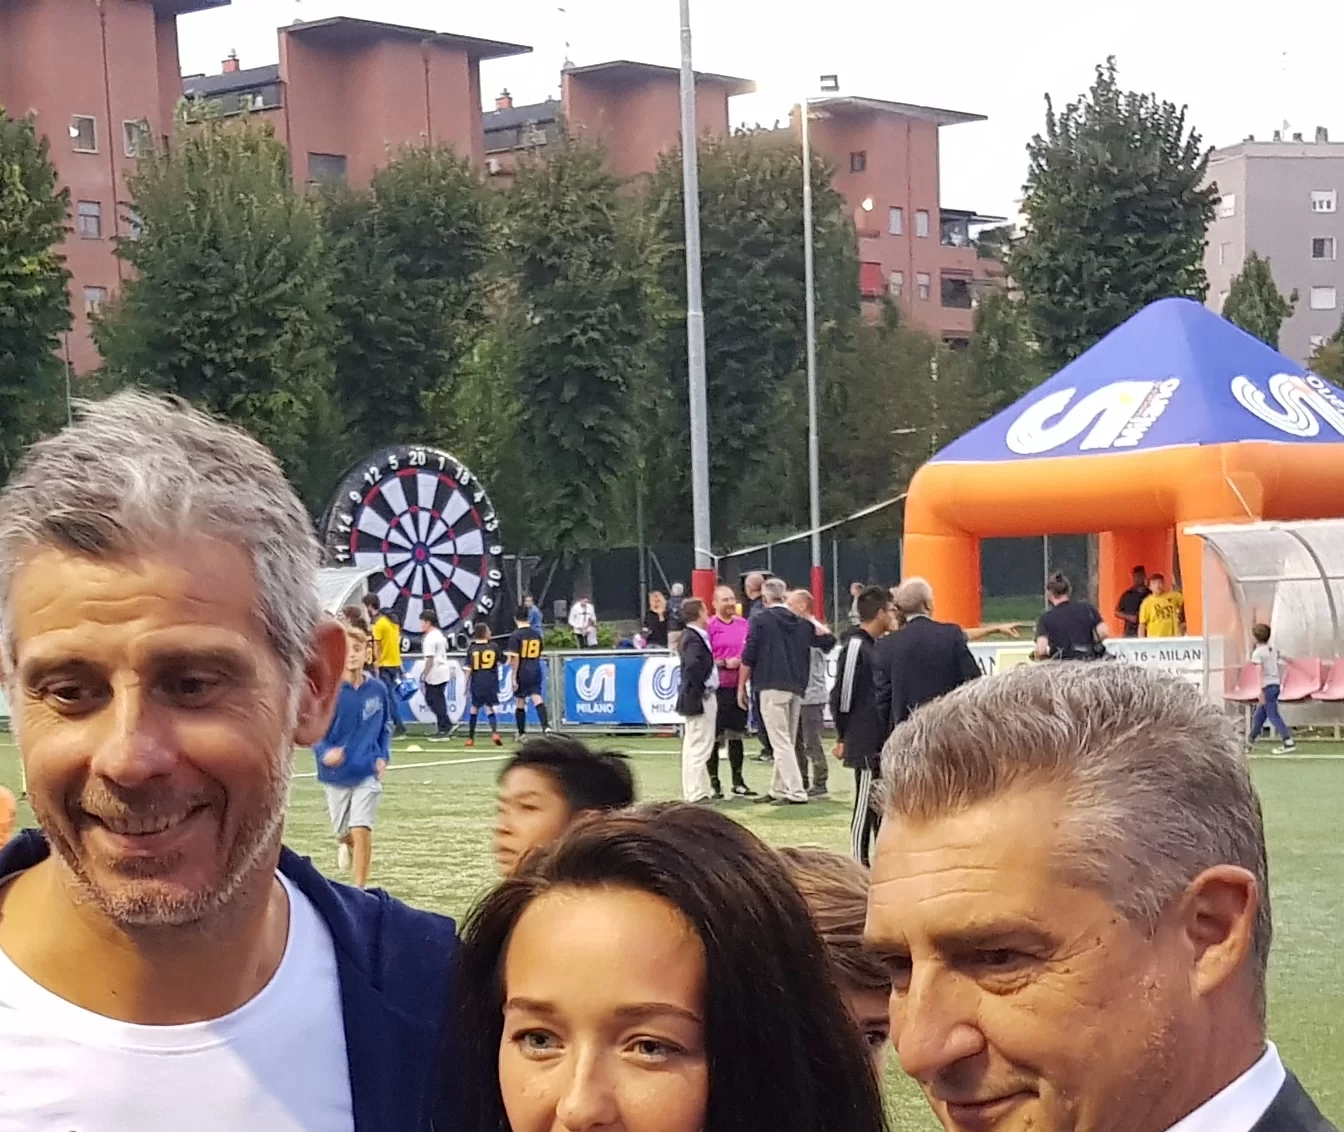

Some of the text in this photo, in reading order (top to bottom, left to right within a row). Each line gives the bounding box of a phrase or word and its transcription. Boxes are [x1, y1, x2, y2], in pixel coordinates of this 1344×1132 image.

[388, 455, 399, 470] 5
[409, 451, 426, 465] 20
[438, 457, 446, 470] 1
[363, 466, 382, 486] 12
[455, 465, 470, 486] 18
[349, 490, 361, 504] 9
[473, 490, 484, 504] 4
[337, 514, 353, 533] 14
[483, 512, 499, 531] 13
[336, 545, 350, 562] 11
[489, 545, 502, 555] 6
[487, 570, 502, 588] 10
[476, 597, 495, 615] 15
[401, 638, 411, 651] 9
[521, 639, 541, 659] 18
[472, 650, 496, 670] 19
[1159, 649, 1201, 660] MILAN
[576, 703, 615, 714] MILANO
[651, 703, 677, 713] MILA
